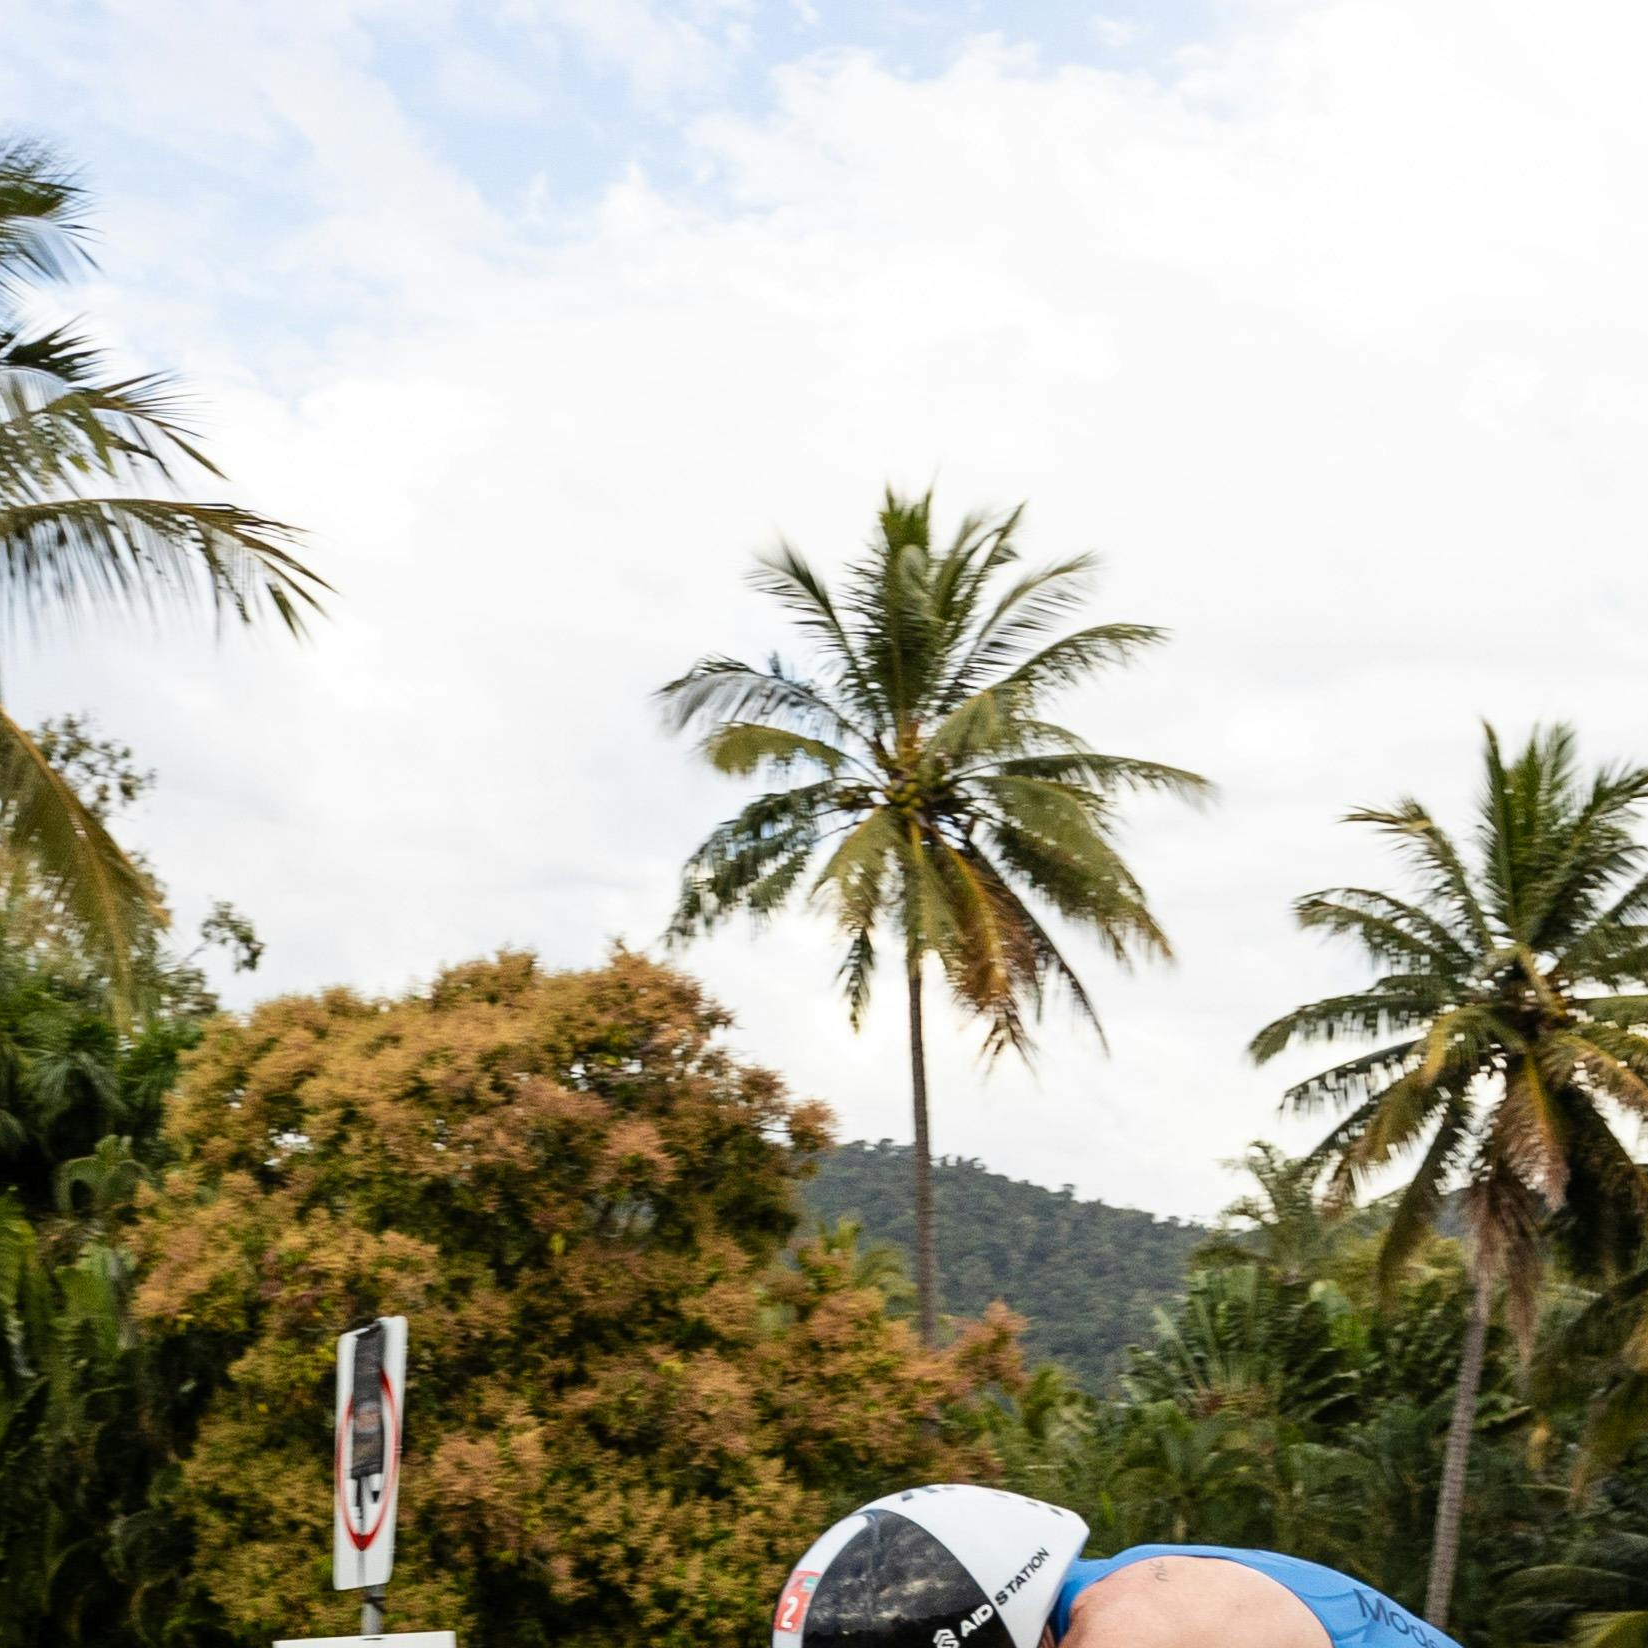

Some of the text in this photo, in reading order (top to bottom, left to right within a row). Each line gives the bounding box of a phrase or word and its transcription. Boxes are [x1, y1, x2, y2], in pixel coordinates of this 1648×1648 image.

[780, 1595, 799, 1629] 2
[959, 1546, 1050, 1638] AID STATION
